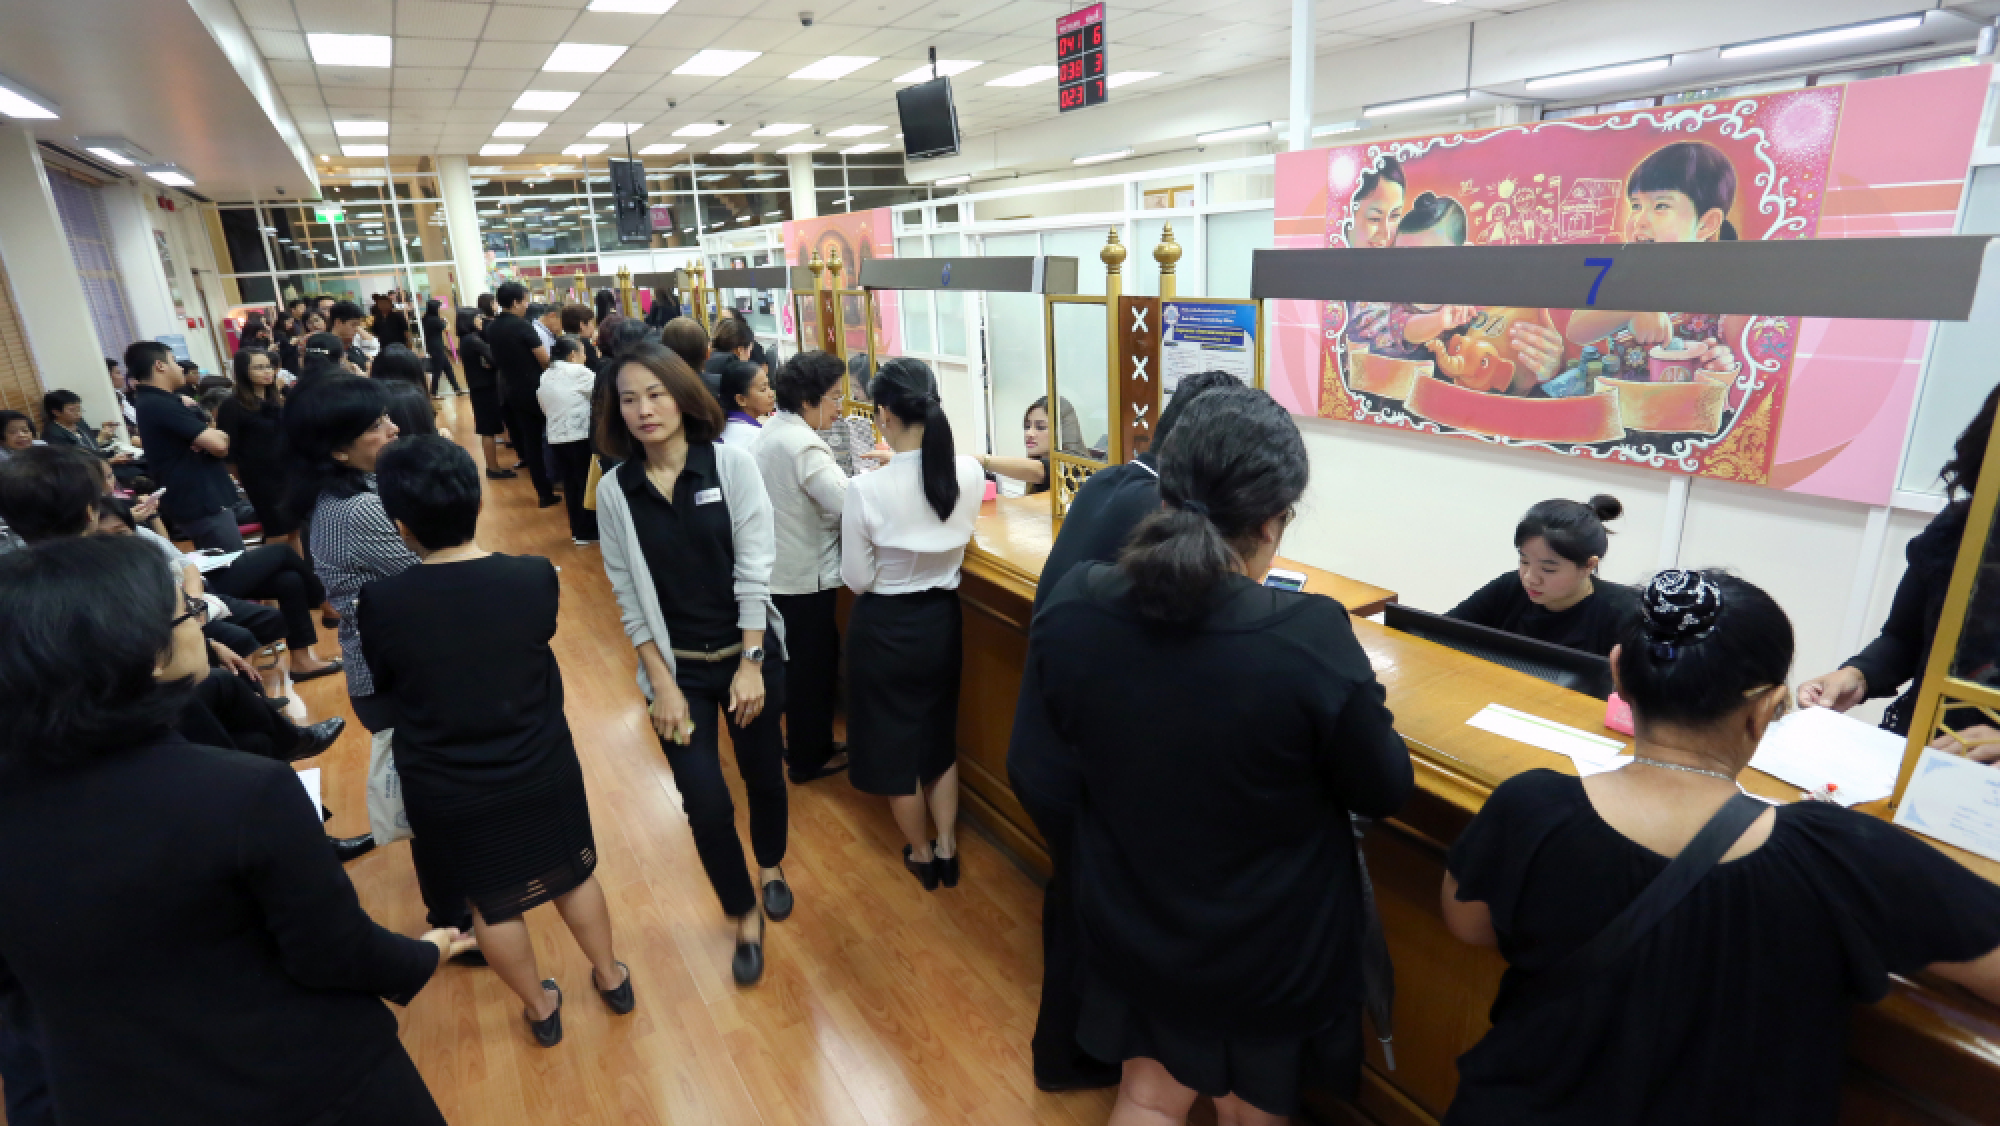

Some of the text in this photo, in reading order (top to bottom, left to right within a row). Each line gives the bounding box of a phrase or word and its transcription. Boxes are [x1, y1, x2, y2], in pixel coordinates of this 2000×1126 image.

[1059, 26, 1101, 56] 041 6
[1095, 53, 1102, 72] 3
[1061, 80, 1103, 108] 023 7
[942, 262, 952, 286] 6
[1584, 257, 1613, 305] 7
